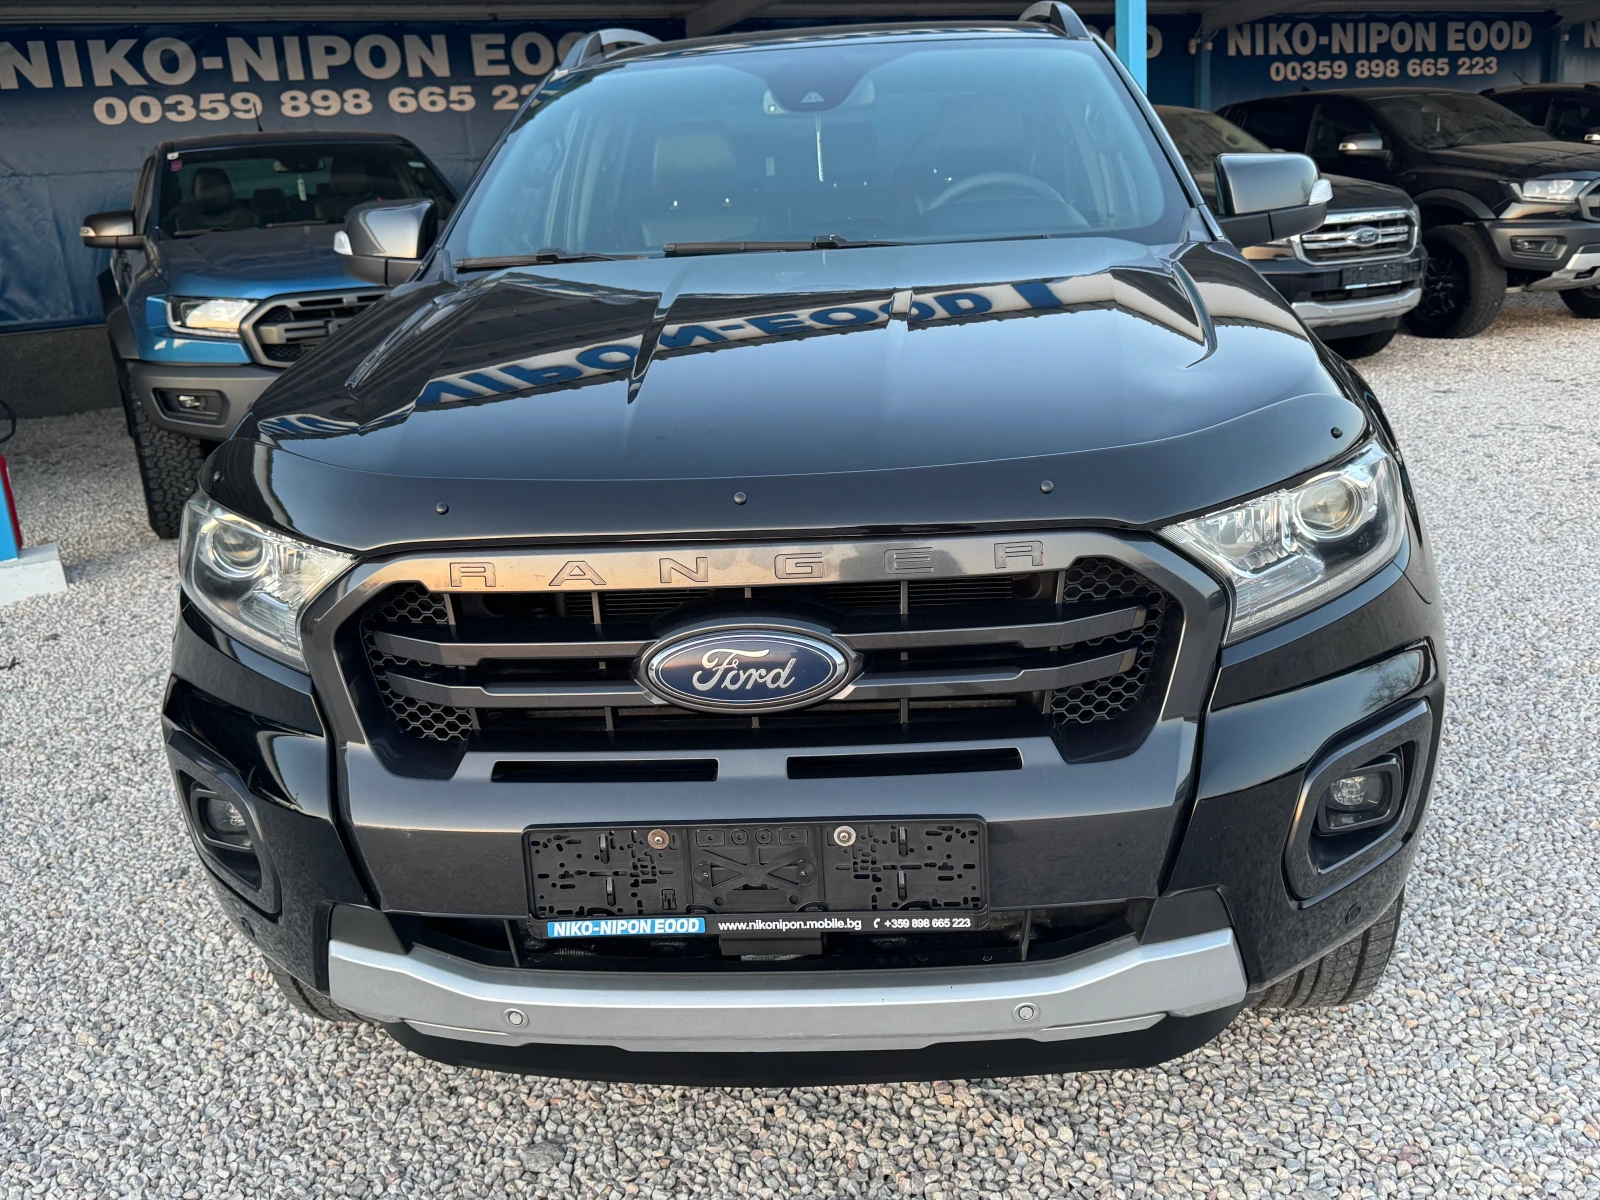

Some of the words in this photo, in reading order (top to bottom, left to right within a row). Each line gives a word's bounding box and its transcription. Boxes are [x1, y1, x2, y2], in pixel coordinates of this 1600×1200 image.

[1227, 21, 1437, 57] NIKO-NIPON
[1447, 20, 1532, 52] EOOD
[0, 34, 451, 90] NIKO-NIPON
[1269, 60, 1348, 82] 00359
[1355, 58, 1400, 79] 898
[1406, 57, 1450, 77] 665
[1456, 56, 1499, 76] 223
[93, 91, 264, 126] 00359
[280, 88, 374, 118] 898
[387, 83, 477, 113] 665
[449, 539, 1045, 588] RANGER
[692, 648, 797, 691] Ford
[554, 920, 652, 936] NIKO-NIPON
[655, 918, 700, 934] EOOD
[718, 918, 862, 931] www.nikonipon.mobile.bg
[884, 918, 910, 929] +359
[912, 918, 930, 929] 898
[932, 918, 950, 928] 665
[952, 918, 971, 928] 223
